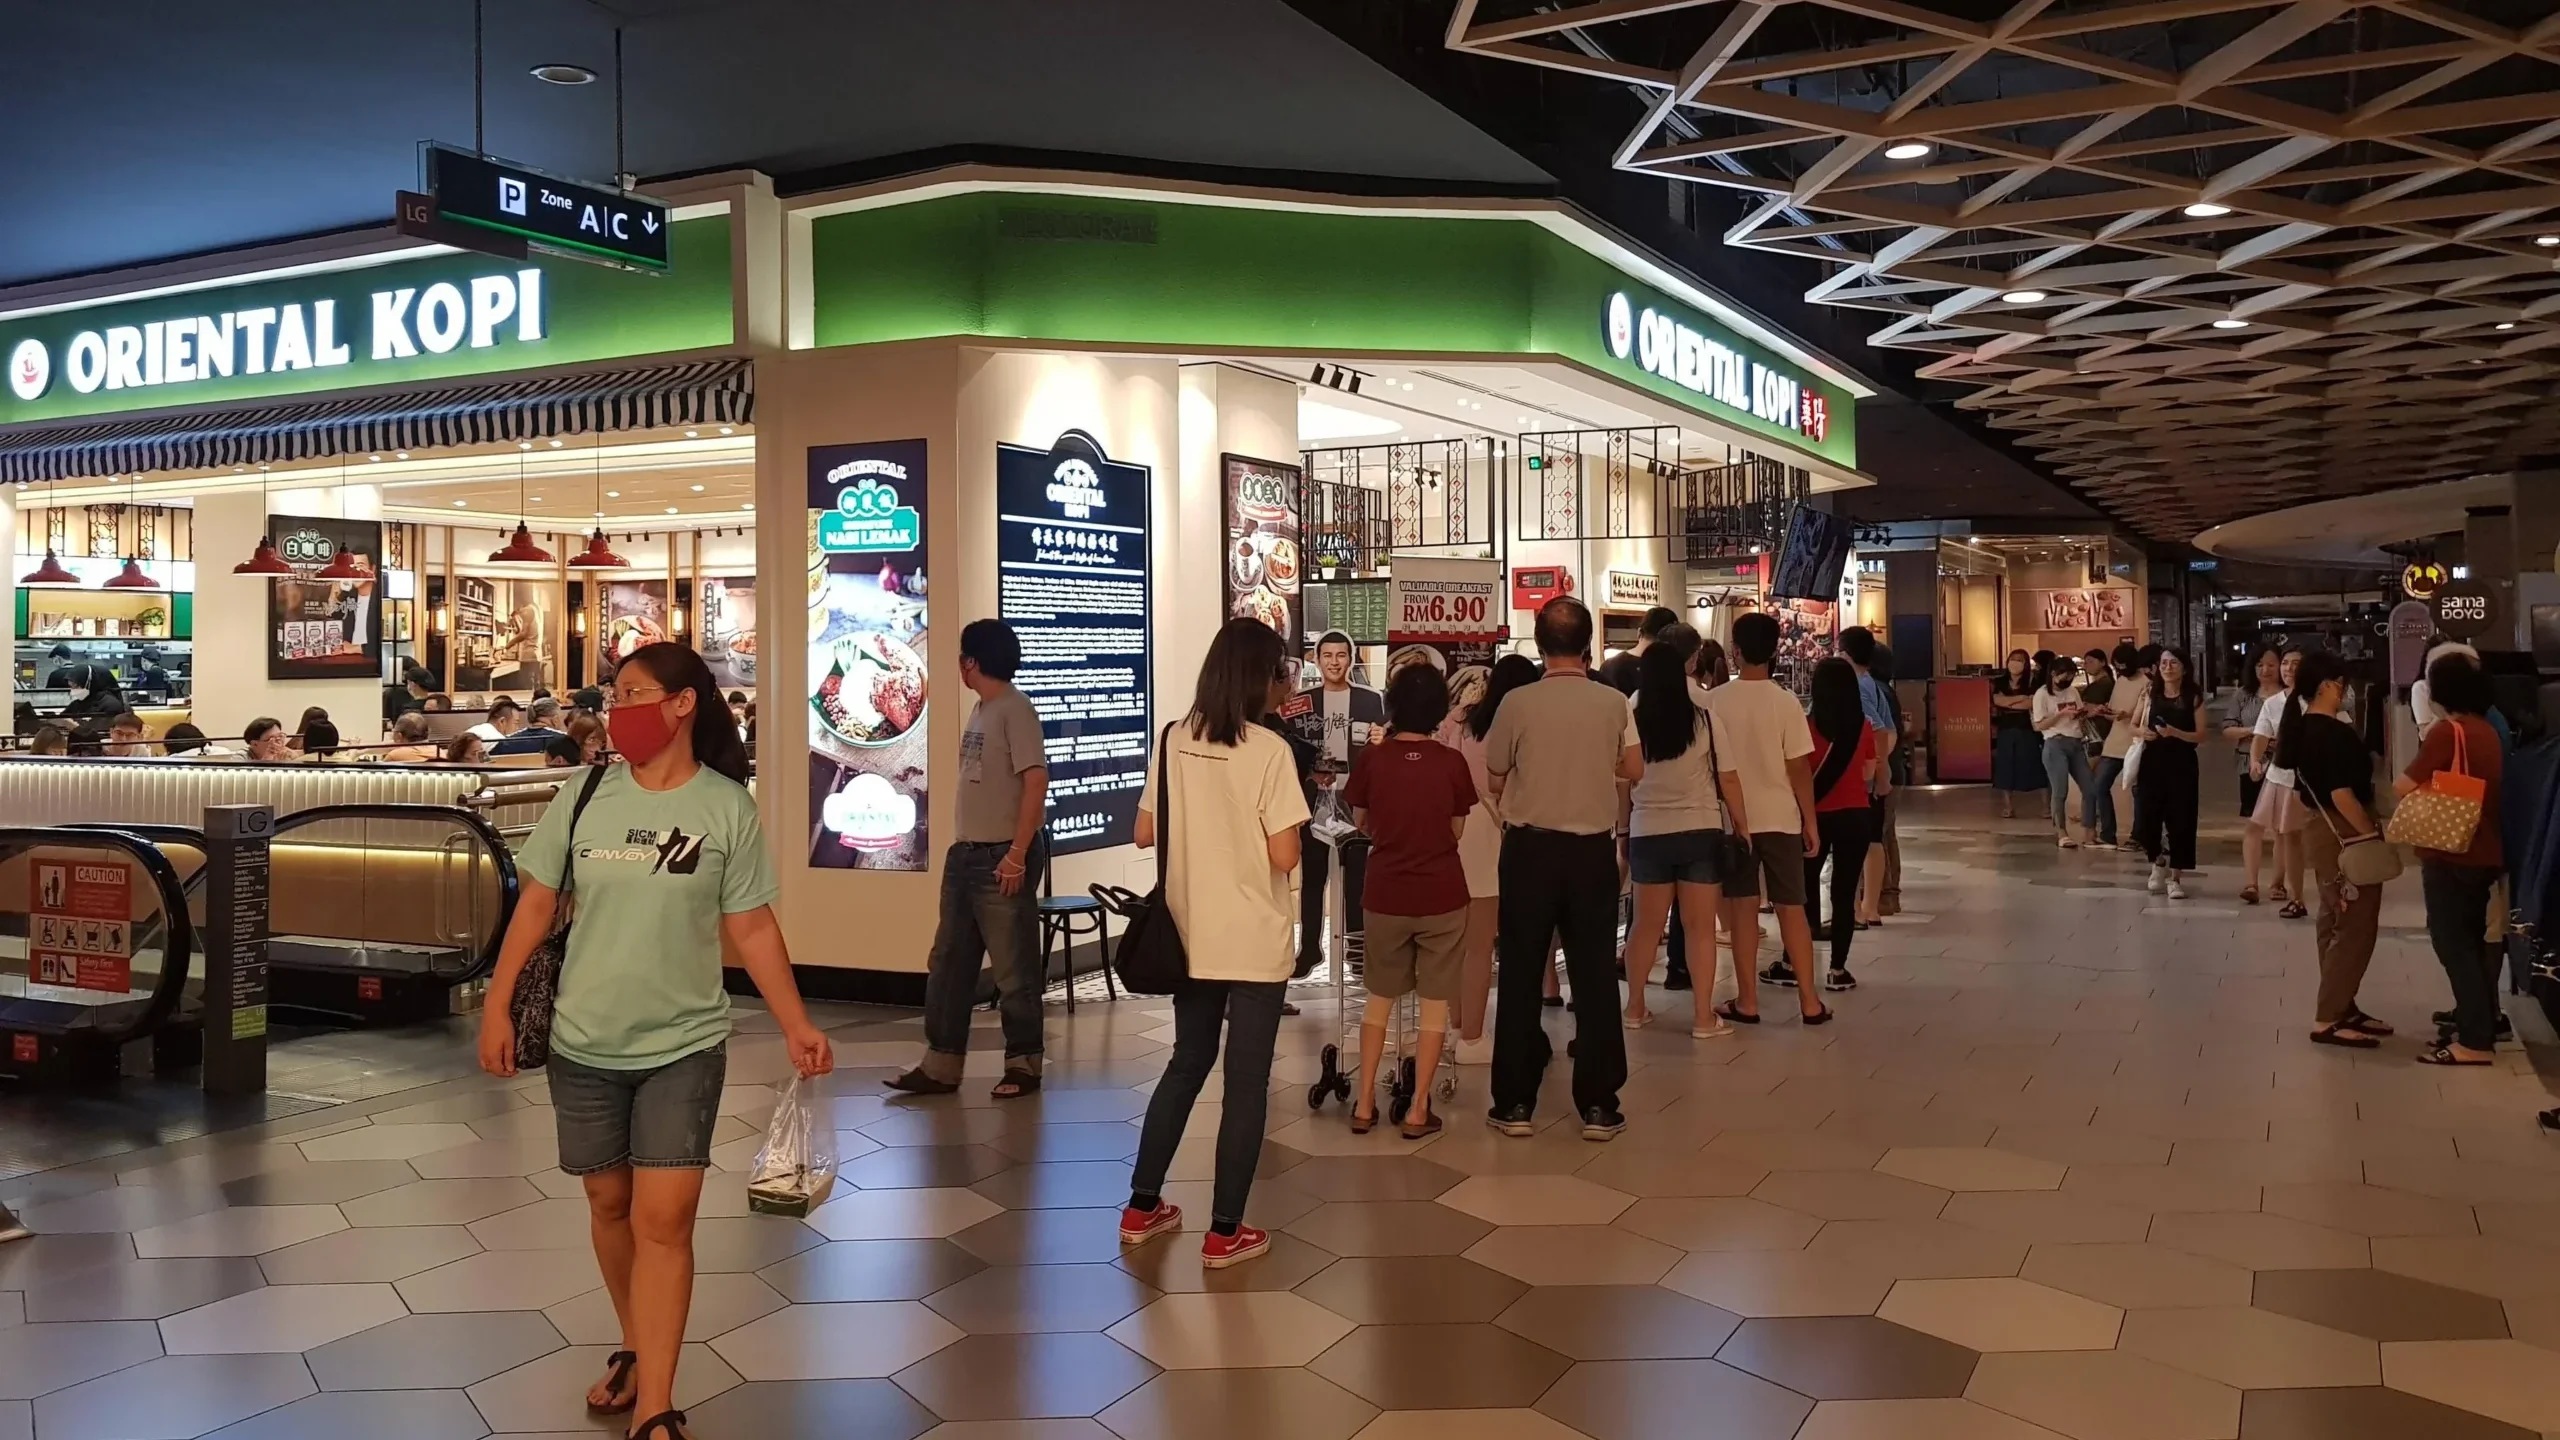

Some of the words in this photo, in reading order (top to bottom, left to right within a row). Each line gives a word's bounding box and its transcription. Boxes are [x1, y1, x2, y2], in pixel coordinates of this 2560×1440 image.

[506, 184, 521, 209] P
[540, 189, 573, 210] Zone
[406, 204, 427, 224] LG
[68, 299, 350, 394] ORIENTAL
[371, 268, 542, 360] KOPI
[1638, 308, 1749, 412] ORIENTAL
[1751, 362, 1800, 430] KOPI
[827, 459, 907, 484] ORIENTAL
[860, 529, 911, 545] LEMAK
[1399, 581, 1444, 592] VALUABLE
[1445, 583, 1493, 594] BREAKFAST
[1404, 594, 1429, 604] FROM
[2441, 596, 2485, 608] sama
[2441, 609, 2485, 620] DOYO
[239, 811, 267, 834] LG
[627, 828, 657, 839] SICM
[580, 848, 654, 862] CONVOY
[78, 867, 123, 883] CAUTION
